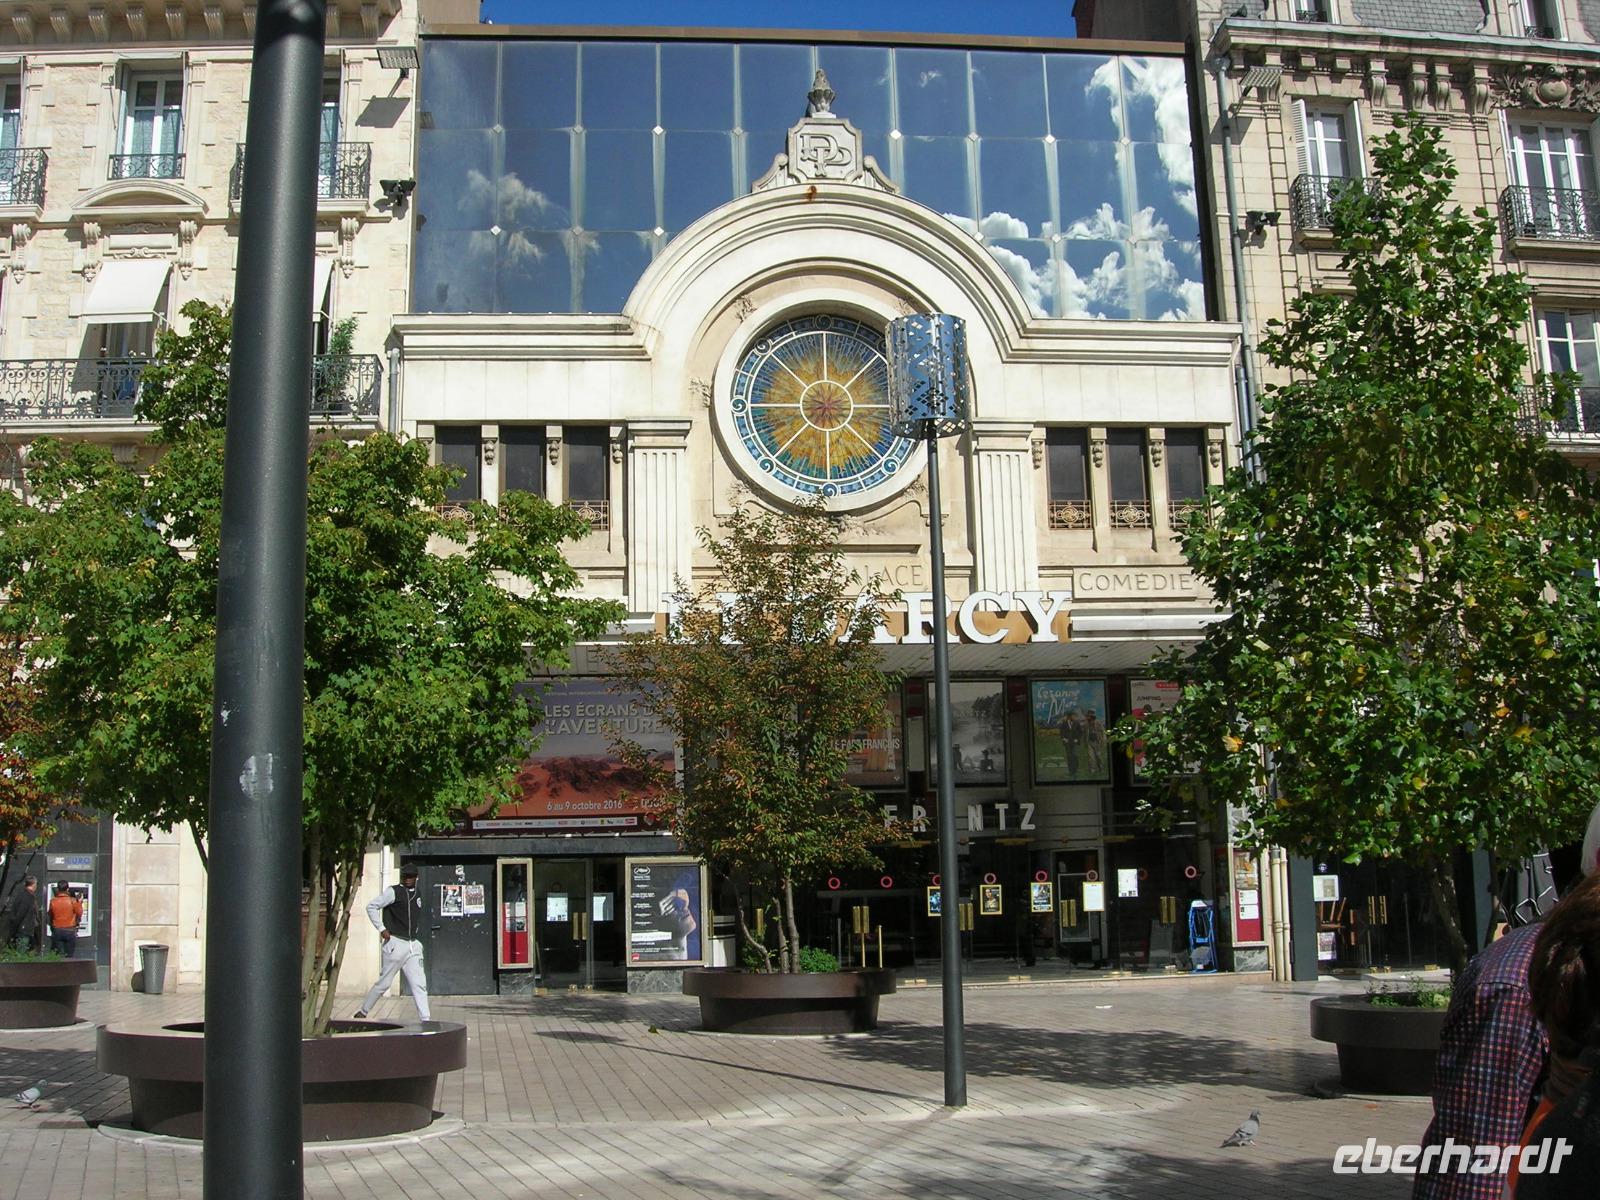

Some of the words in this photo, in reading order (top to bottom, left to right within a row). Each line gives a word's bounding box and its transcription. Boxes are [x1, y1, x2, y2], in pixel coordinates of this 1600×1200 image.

[1079, 572, 1193, 591] COMÉDIE
[544, 704, 571, 718] LES
[575, 702, 639, 718] ÉCRANS
[544, 718, 665, 735] L'AVENTURE
[862, 736, 901, 752] FRANÇOIS
[547, 801, 553, 811] 6
[554, 803, 564, 811] au
[565, 801, 571, 810] 9
[572, 800, 602, 810] octobre
[603, 800, 623, 809] 2016
[883, 803, 1037, 832] FRNTZ
